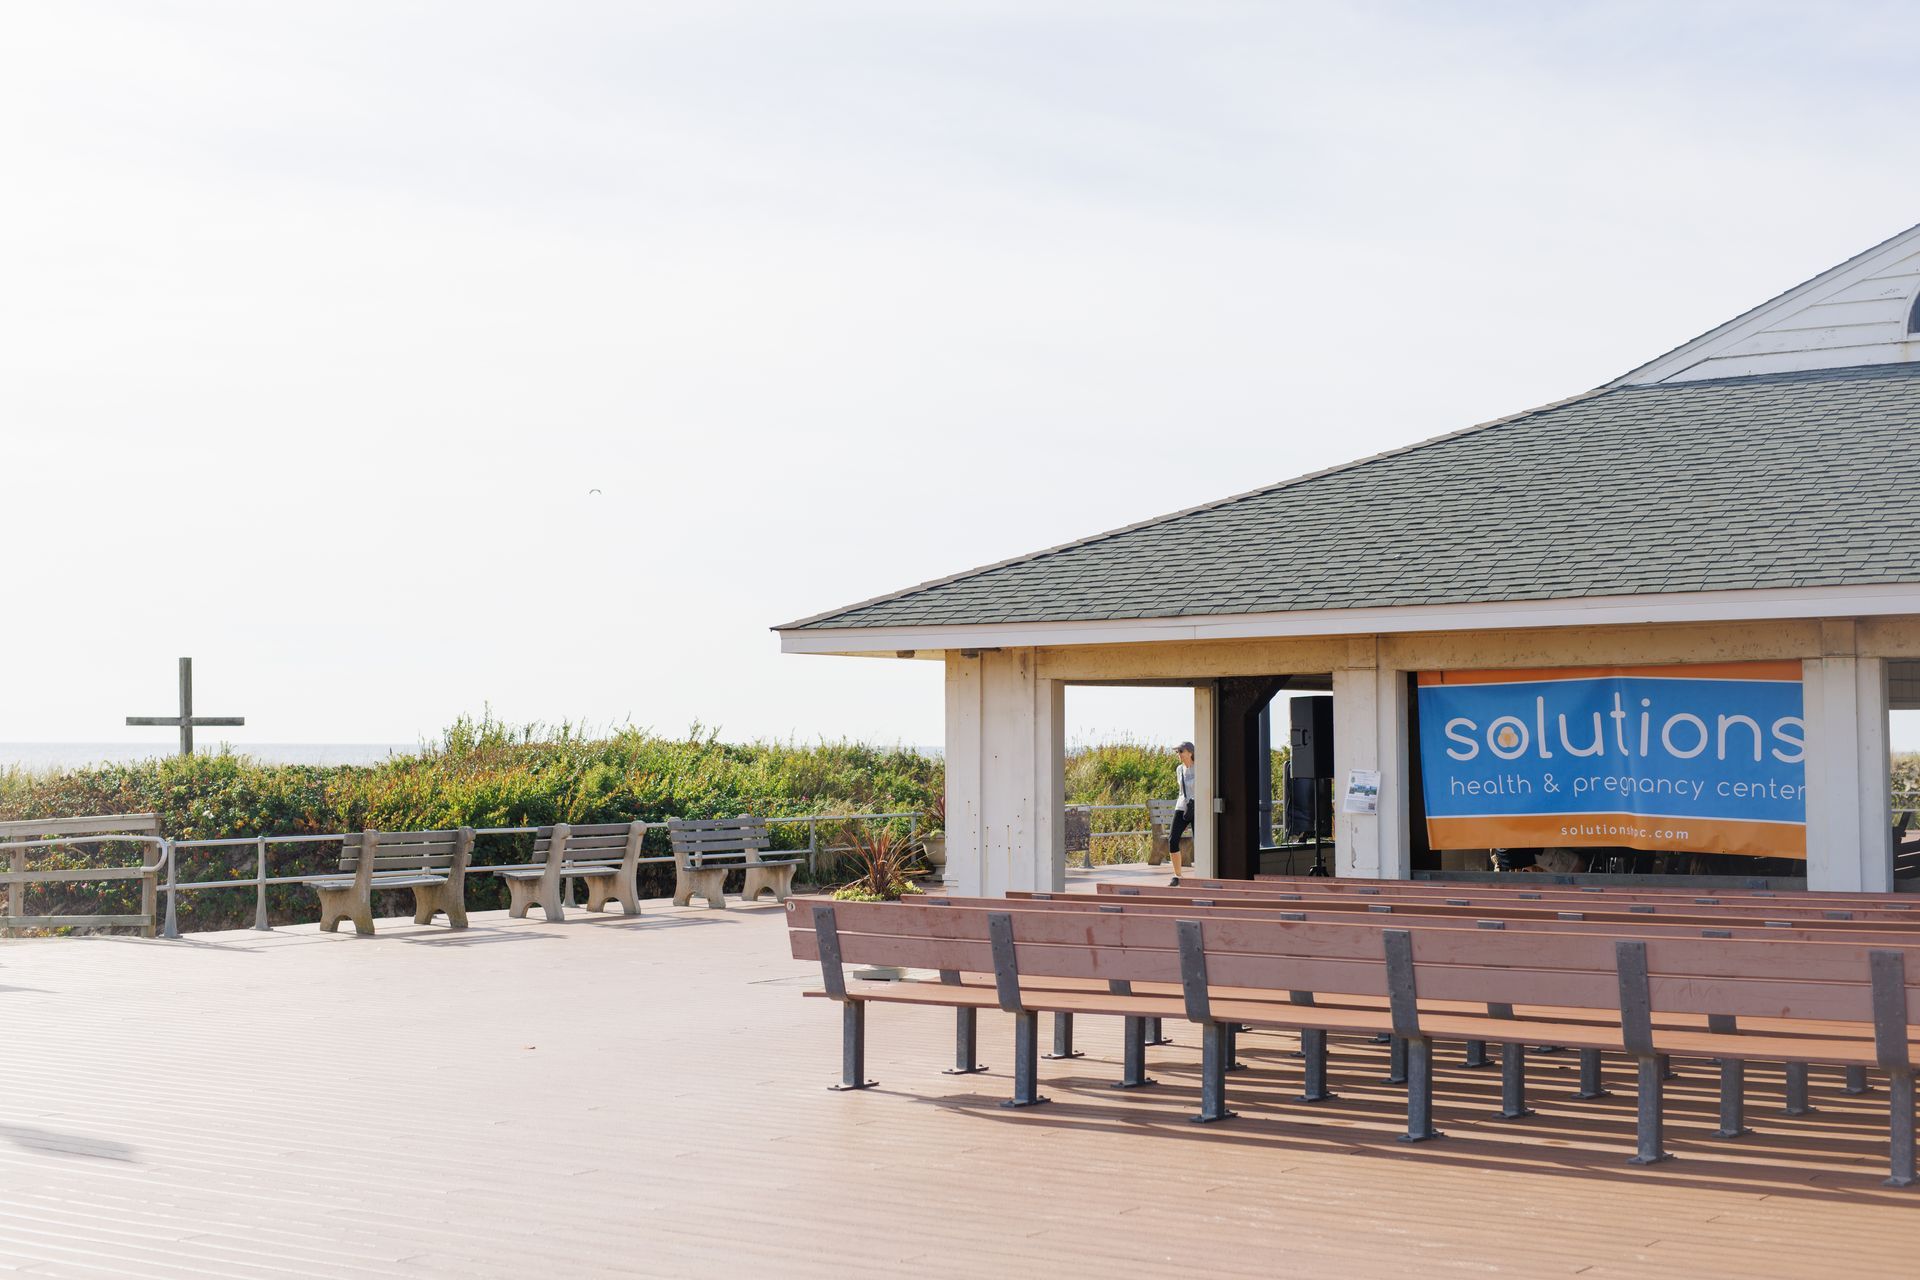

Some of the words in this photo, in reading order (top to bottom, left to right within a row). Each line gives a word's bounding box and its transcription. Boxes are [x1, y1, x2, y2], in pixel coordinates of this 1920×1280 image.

[1445, 692, 1805, 763] solutions
[1451, 774, 1532, 796] health
[1543, 773, 1560, 793] &
[1574, 776, 1704, 800] pregnancy
[1717, 778, 1806, 800] center
